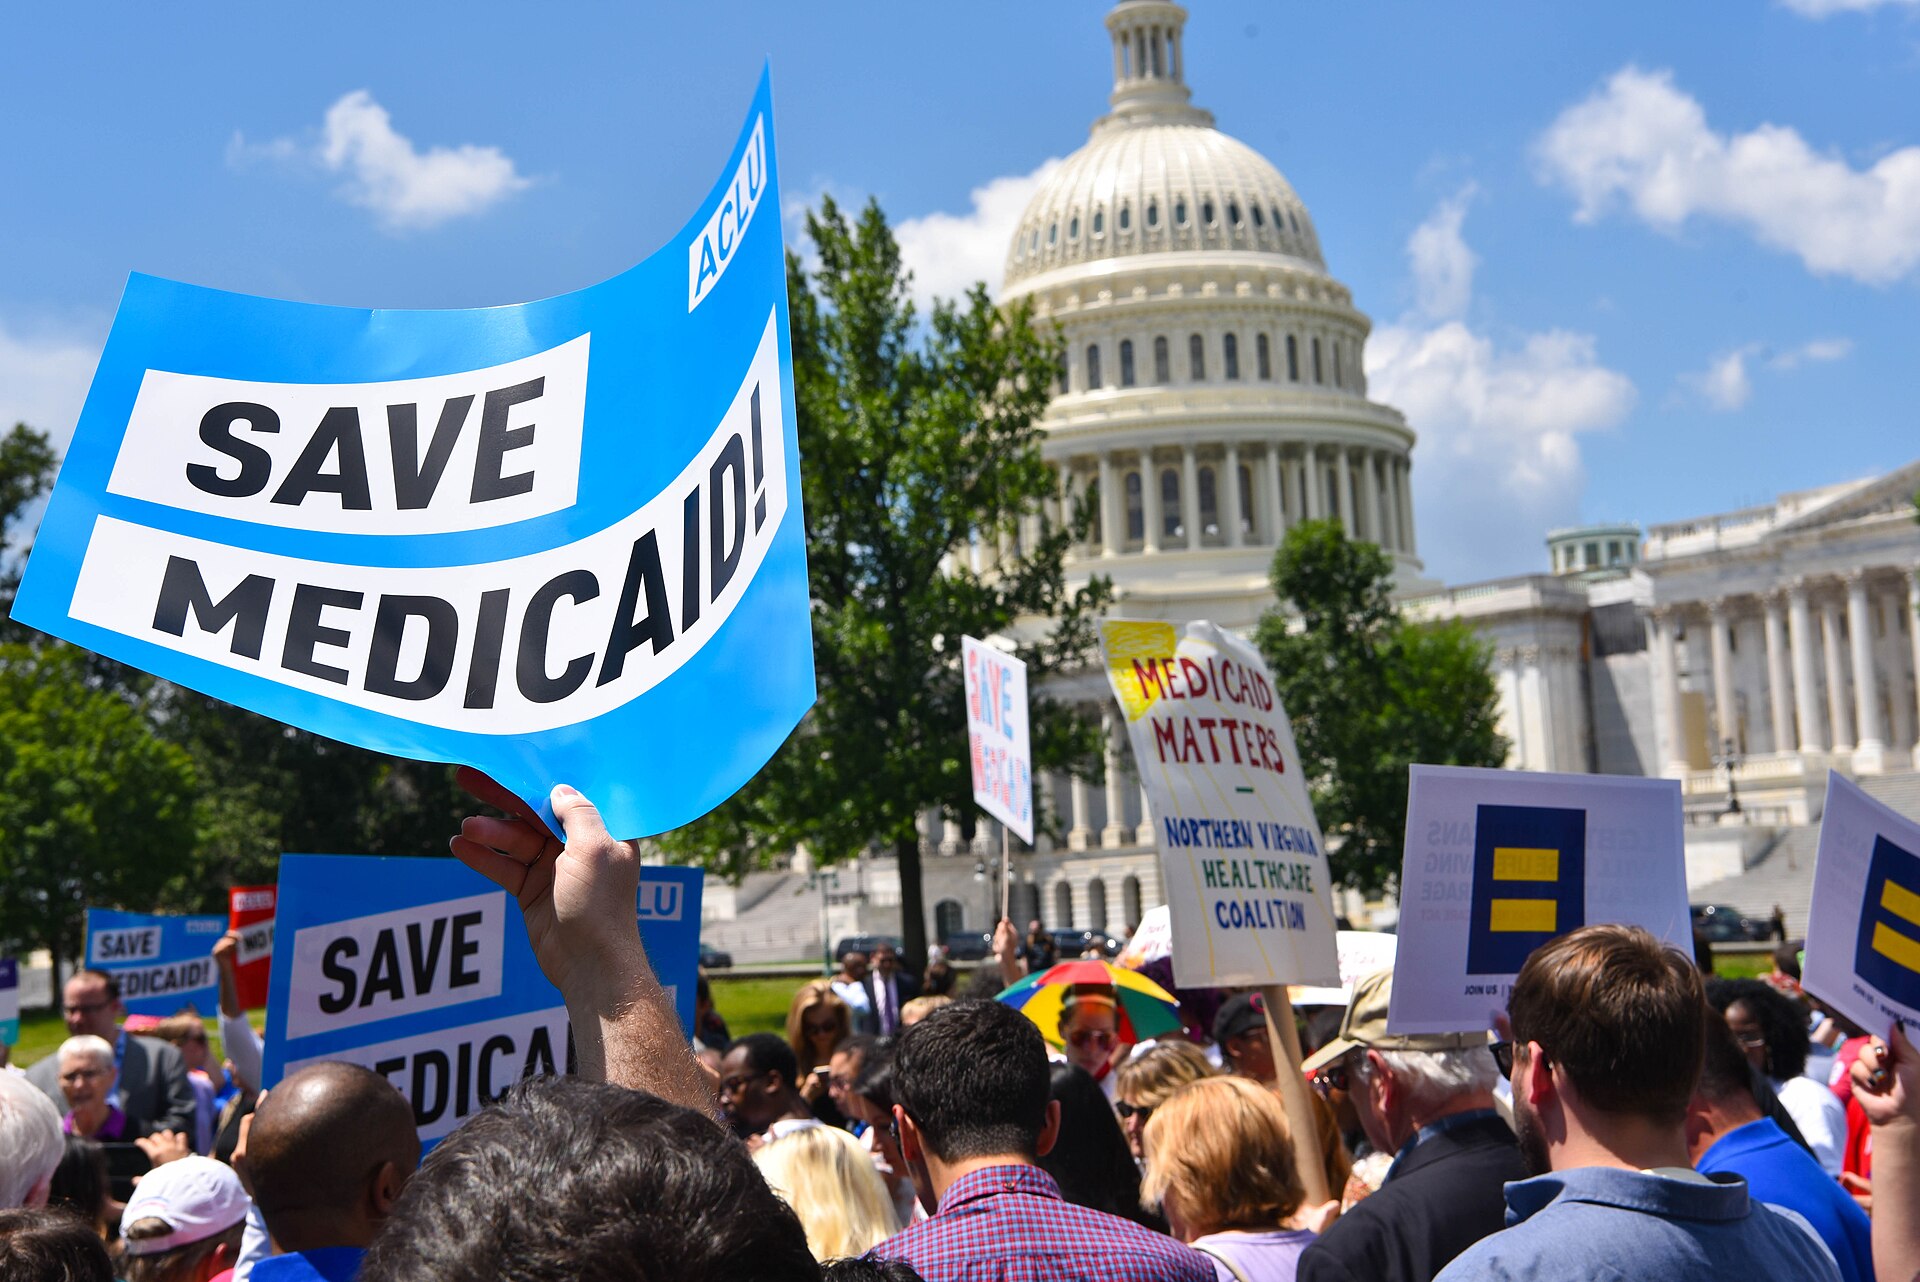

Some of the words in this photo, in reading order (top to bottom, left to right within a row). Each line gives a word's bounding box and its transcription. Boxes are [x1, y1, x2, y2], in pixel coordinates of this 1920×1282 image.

[694, 130, 761, 299] ACLU
[186, 376, 545, 511] SAVE
[152, 380, 767, 710] MEDICAID!
[968, 648, 1013, 741] SAVE
[1132, 656, 1273, 713] MEDICAID
[1151, 717, 1285, 774] MATTERS
[1164, 817, 1253, 850] NORTHERN
[1257, 822, 1319, 858] VIRGINIA
[636, 886, 677, 915] LU
[1202, 859, 1315, 893] HEALTHCARE
[1215, 900, 1307, 931] COALITION
[101, 930, 156, 957] SAVE
[318, 911, 483, 1014] SAVE
[115, 960, 210, 995] EDICAID!
[1464, 984, 1484, 995] JOIN
[1485, 984, 1498, 995] US
